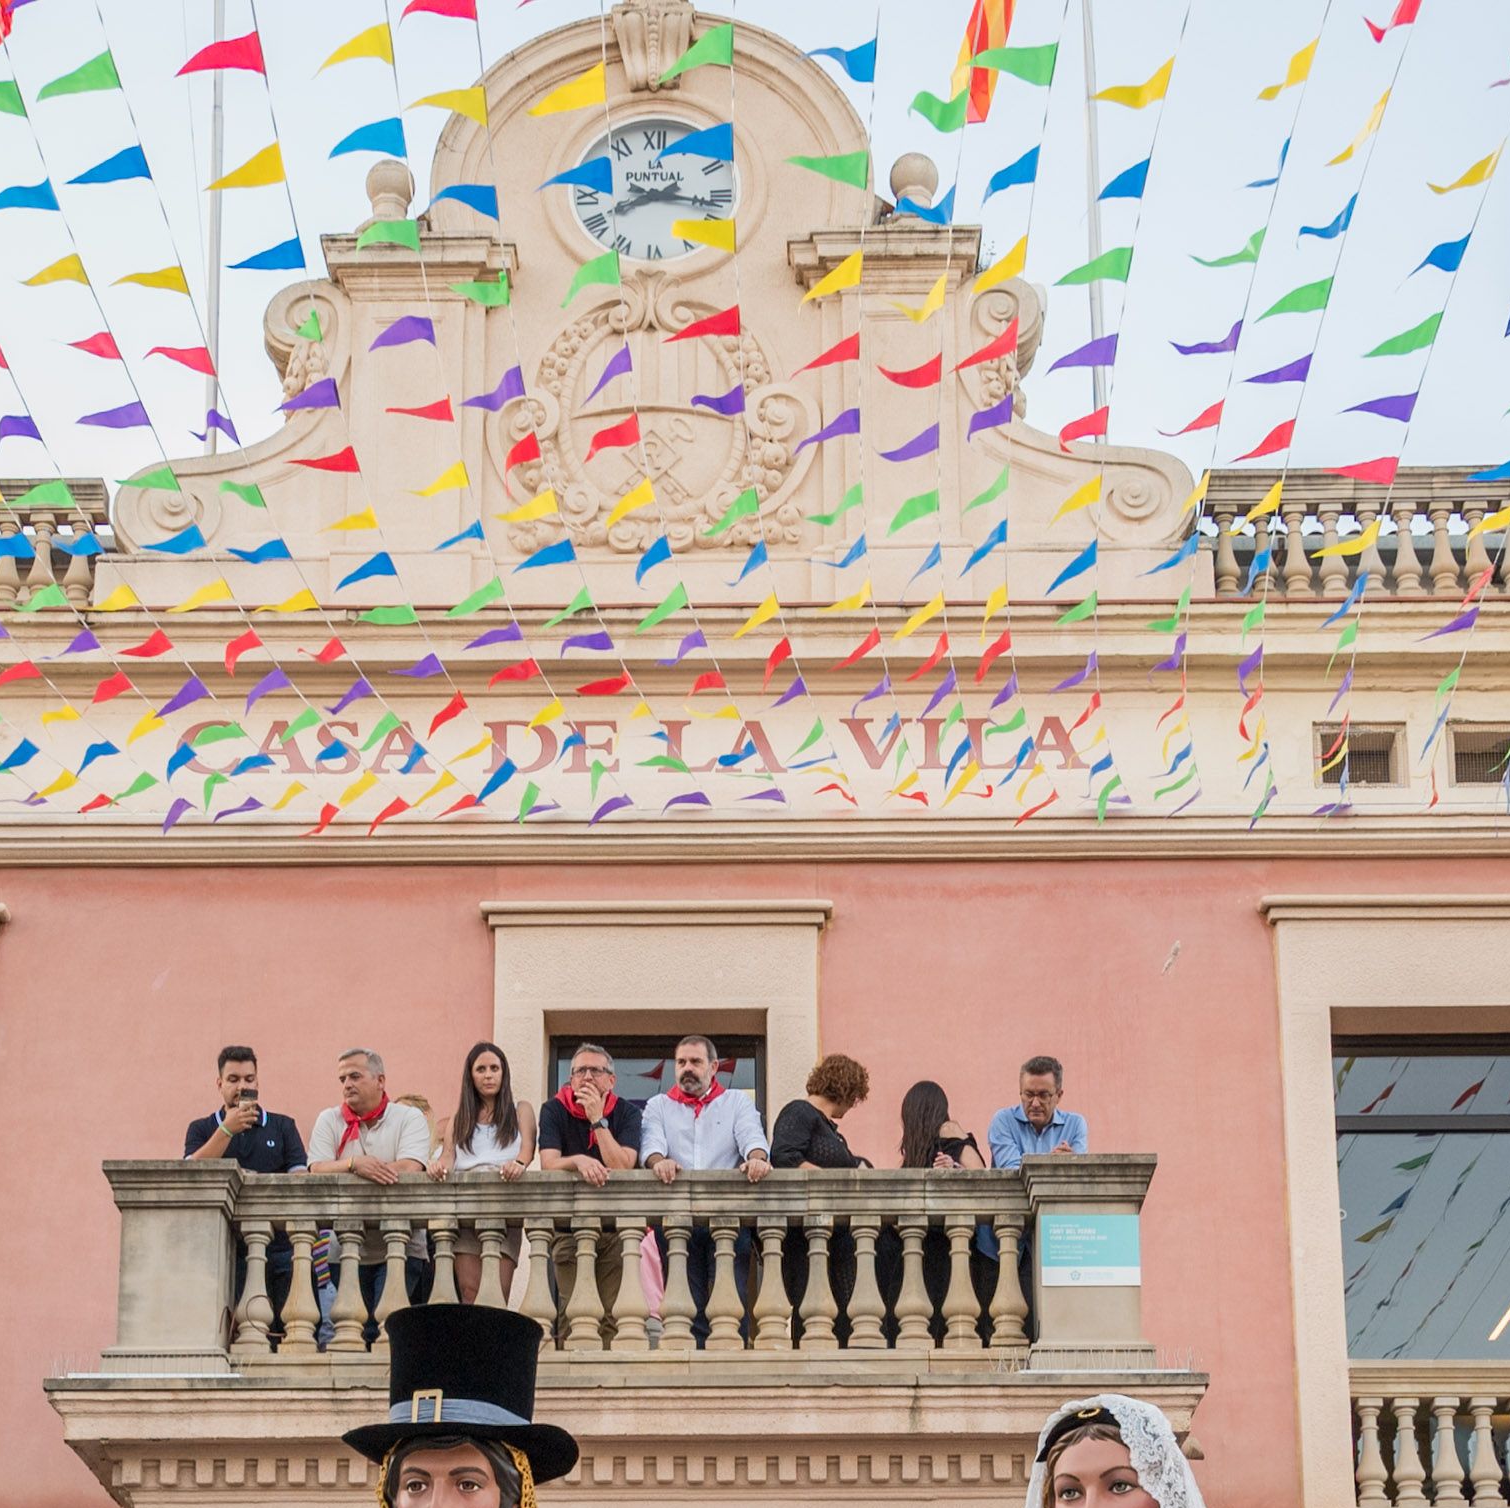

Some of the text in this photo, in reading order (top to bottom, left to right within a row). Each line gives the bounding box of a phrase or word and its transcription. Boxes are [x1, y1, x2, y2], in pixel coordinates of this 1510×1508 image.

[643, 131, 667, 150] XII
[648, 160, 663, 169] LA
[626, 172, 684, 181] PUNTUAL
[176, 716, 1089, 774] CASA DE LA VILA
